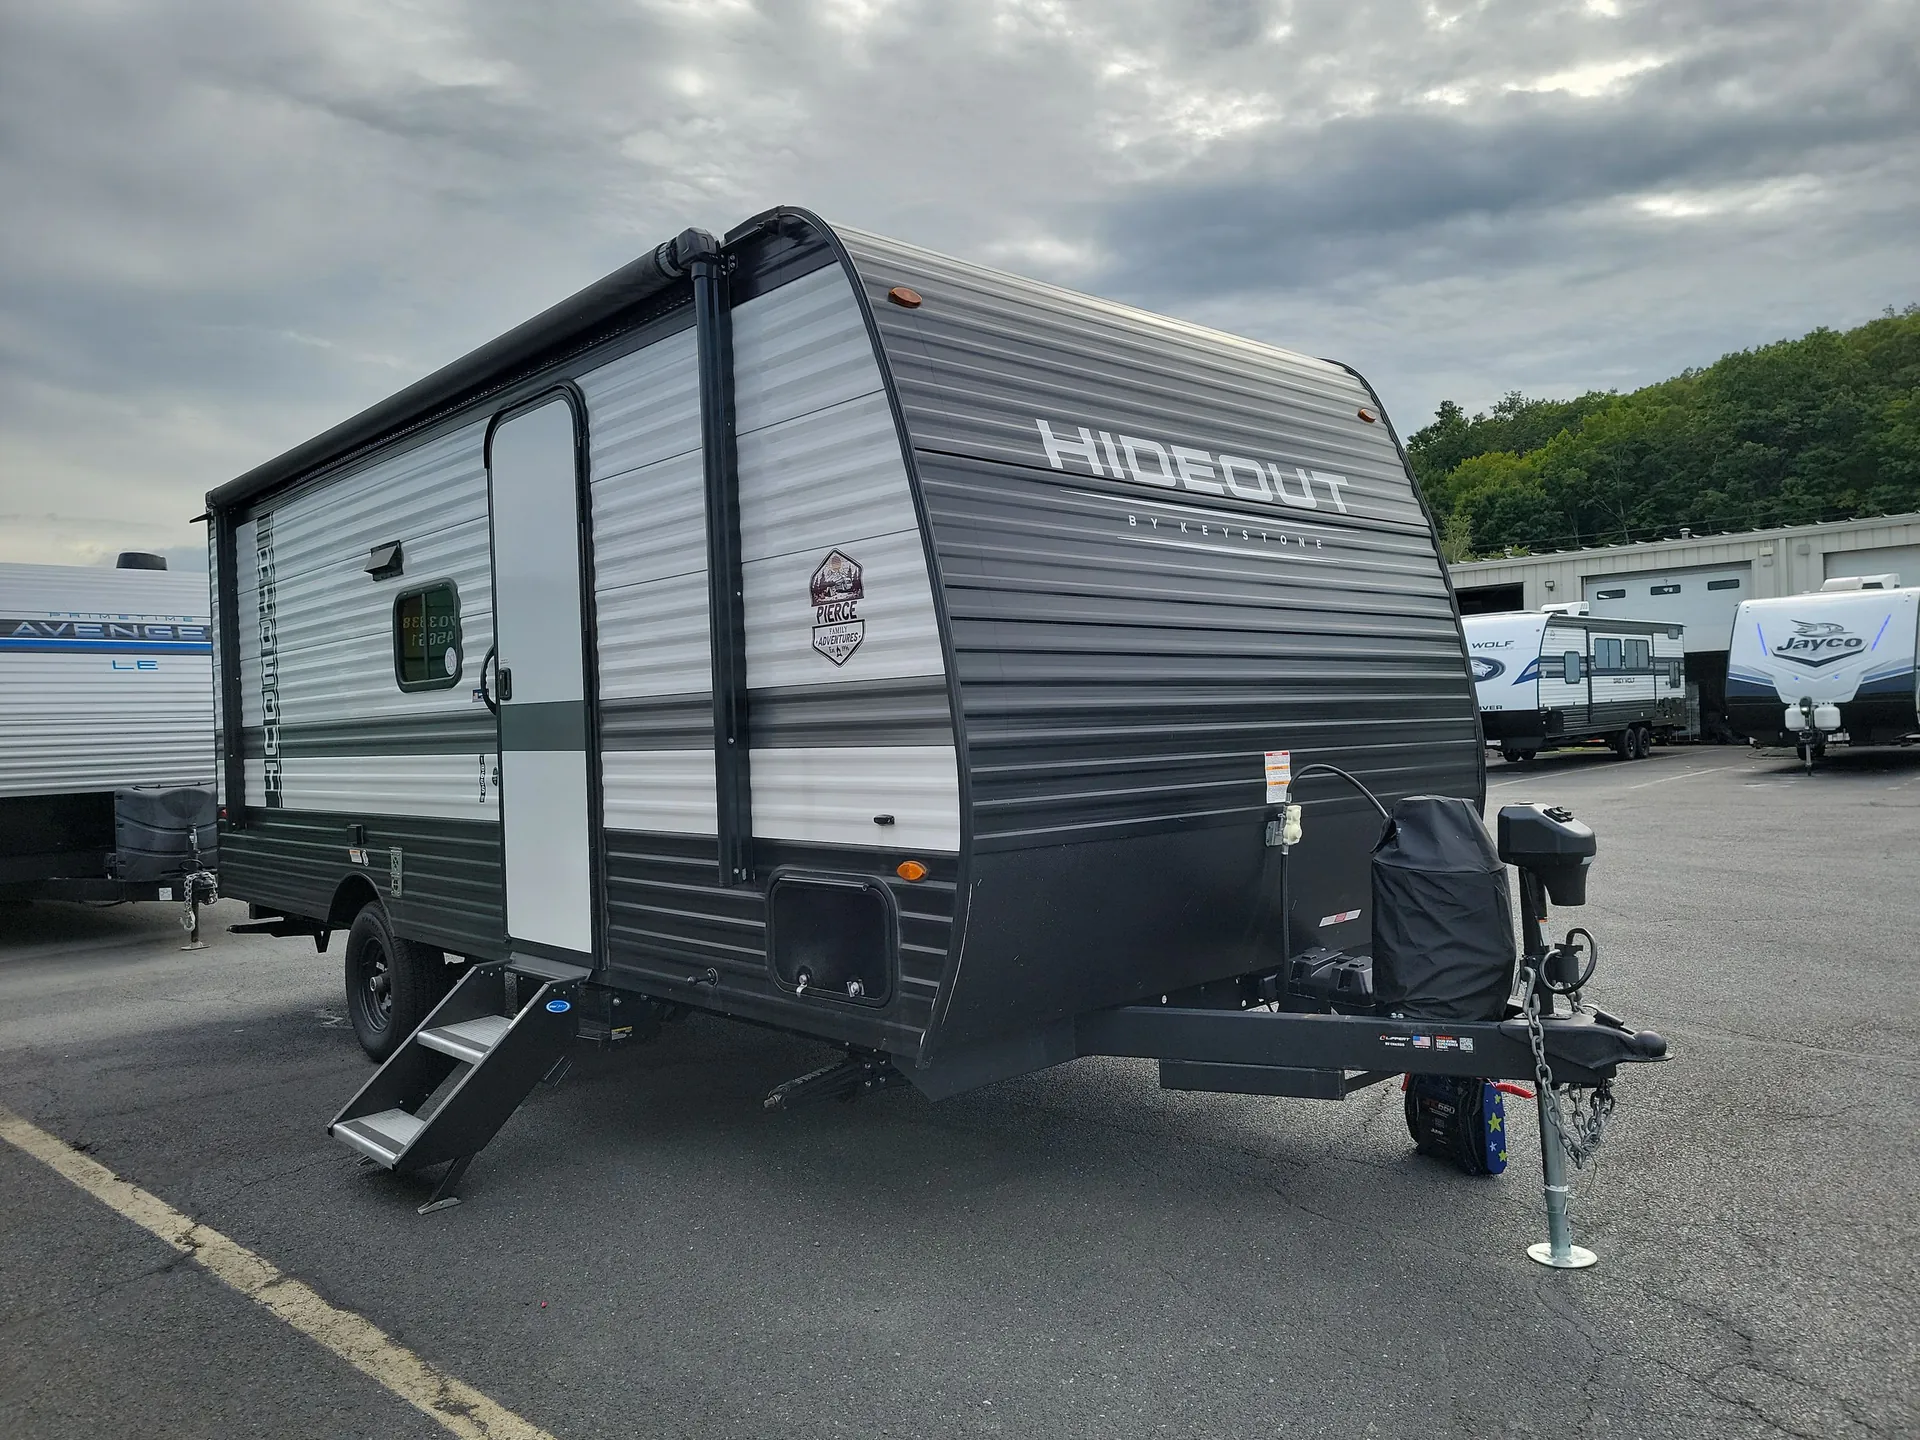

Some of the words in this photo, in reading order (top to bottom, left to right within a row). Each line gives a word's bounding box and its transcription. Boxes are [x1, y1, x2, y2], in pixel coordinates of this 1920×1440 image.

[1036, 419, 1349, 513] HIDEOUT
[1128, 515, 1159, 529] BY
[1180, 521, 1322, 550] KEYSTONE
[816, 601, 858, 624] PIERCE
[829, 626, 848, 635] FAMILY
[818, 632, 858, 646] ADVENTURES
[1472, 640, 1514, 649] WOLF
[1776, 637, 1863, 651] Jayco
[112, 660, 159, 670] LE
